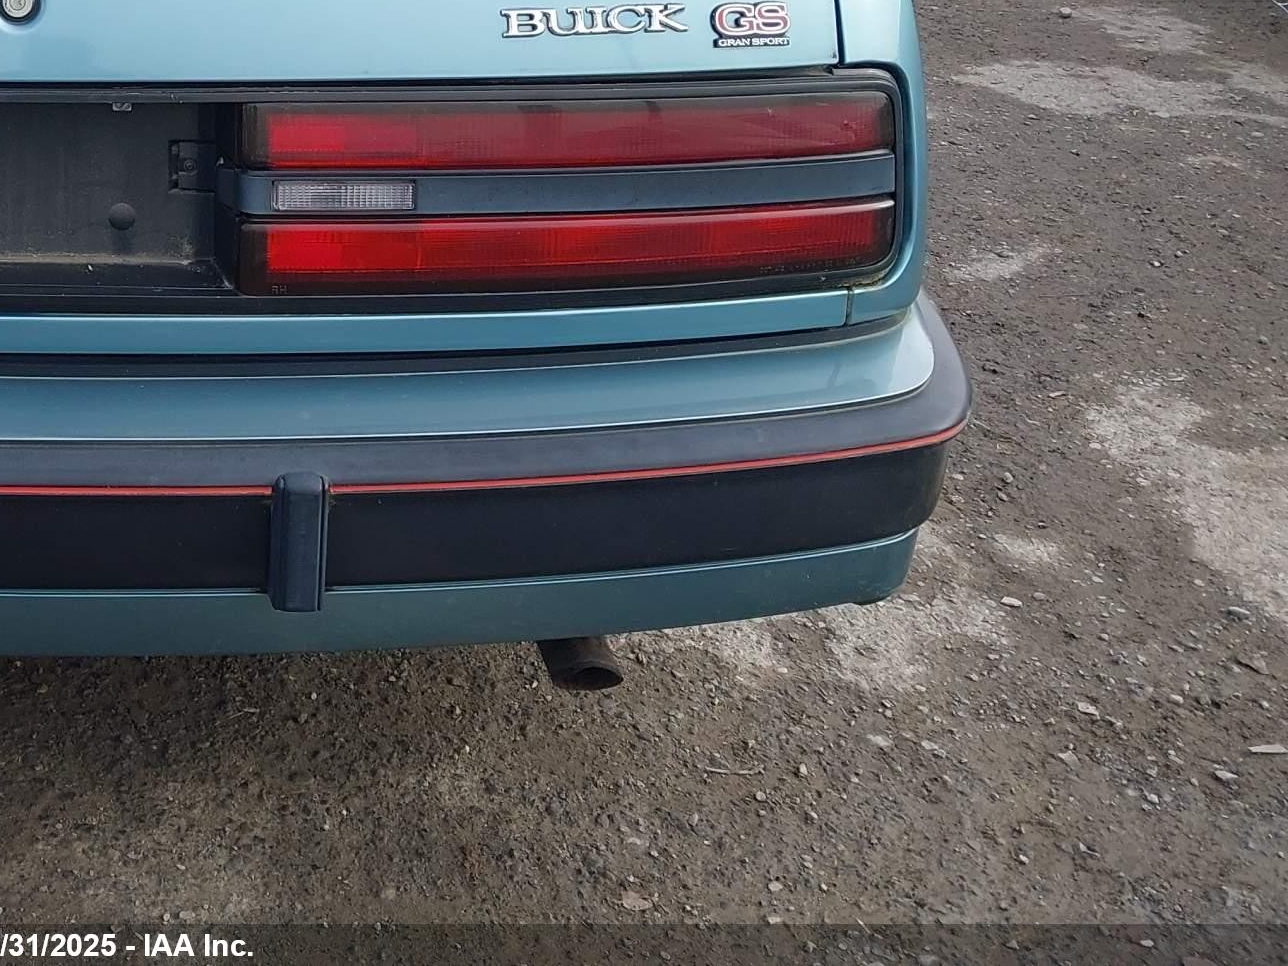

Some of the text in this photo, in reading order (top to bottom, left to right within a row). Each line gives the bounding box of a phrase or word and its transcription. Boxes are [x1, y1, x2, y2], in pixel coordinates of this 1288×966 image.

[501, 3, 689, 39] BUICK
[713, 1, 791, 36] GS
[718, 36, 790, 47] GRAN SPORT
